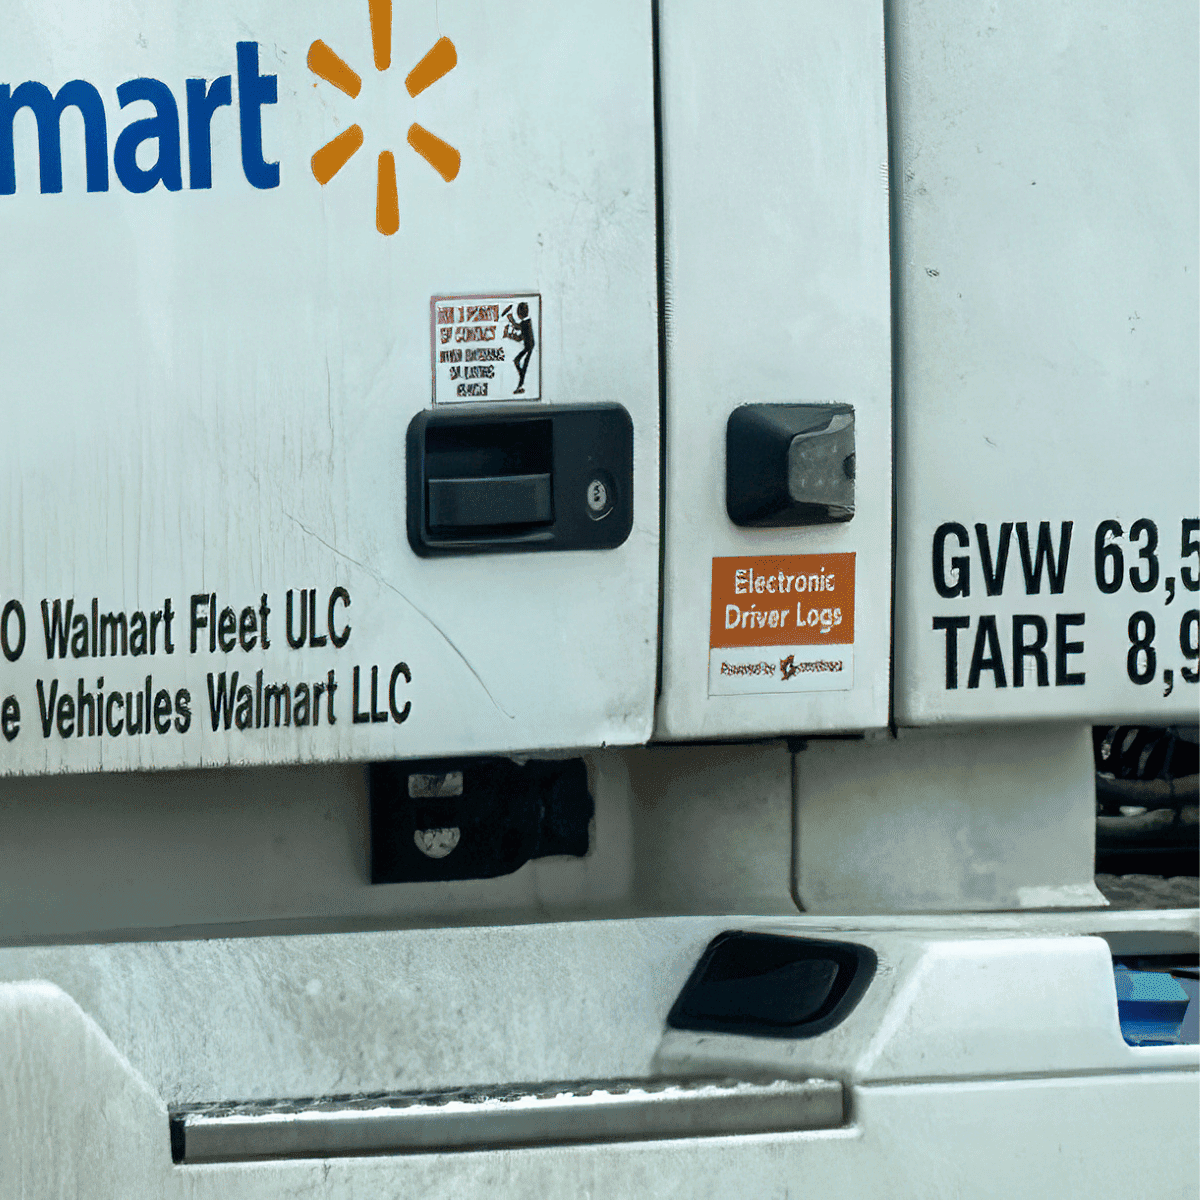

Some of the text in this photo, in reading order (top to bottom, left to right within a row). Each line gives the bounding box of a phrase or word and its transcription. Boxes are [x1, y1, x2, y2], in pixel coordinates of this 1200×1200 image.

[734, 566, 836, 595] Electronic
[931, 520, 1074, 599] GVW
[40, 597, 175, 660] Walmart
[189, 592, 271, 654] Fleet
[285, 586, 352, 649] ULC
[725, 601, 843, 634] Driver Logs
[932, 612, 1086, 690] TARE
[35, 674, 193, 740] Vehicules
[206, 668, 338, 733] Walmart
[352, 661, 412, 725] LLC
